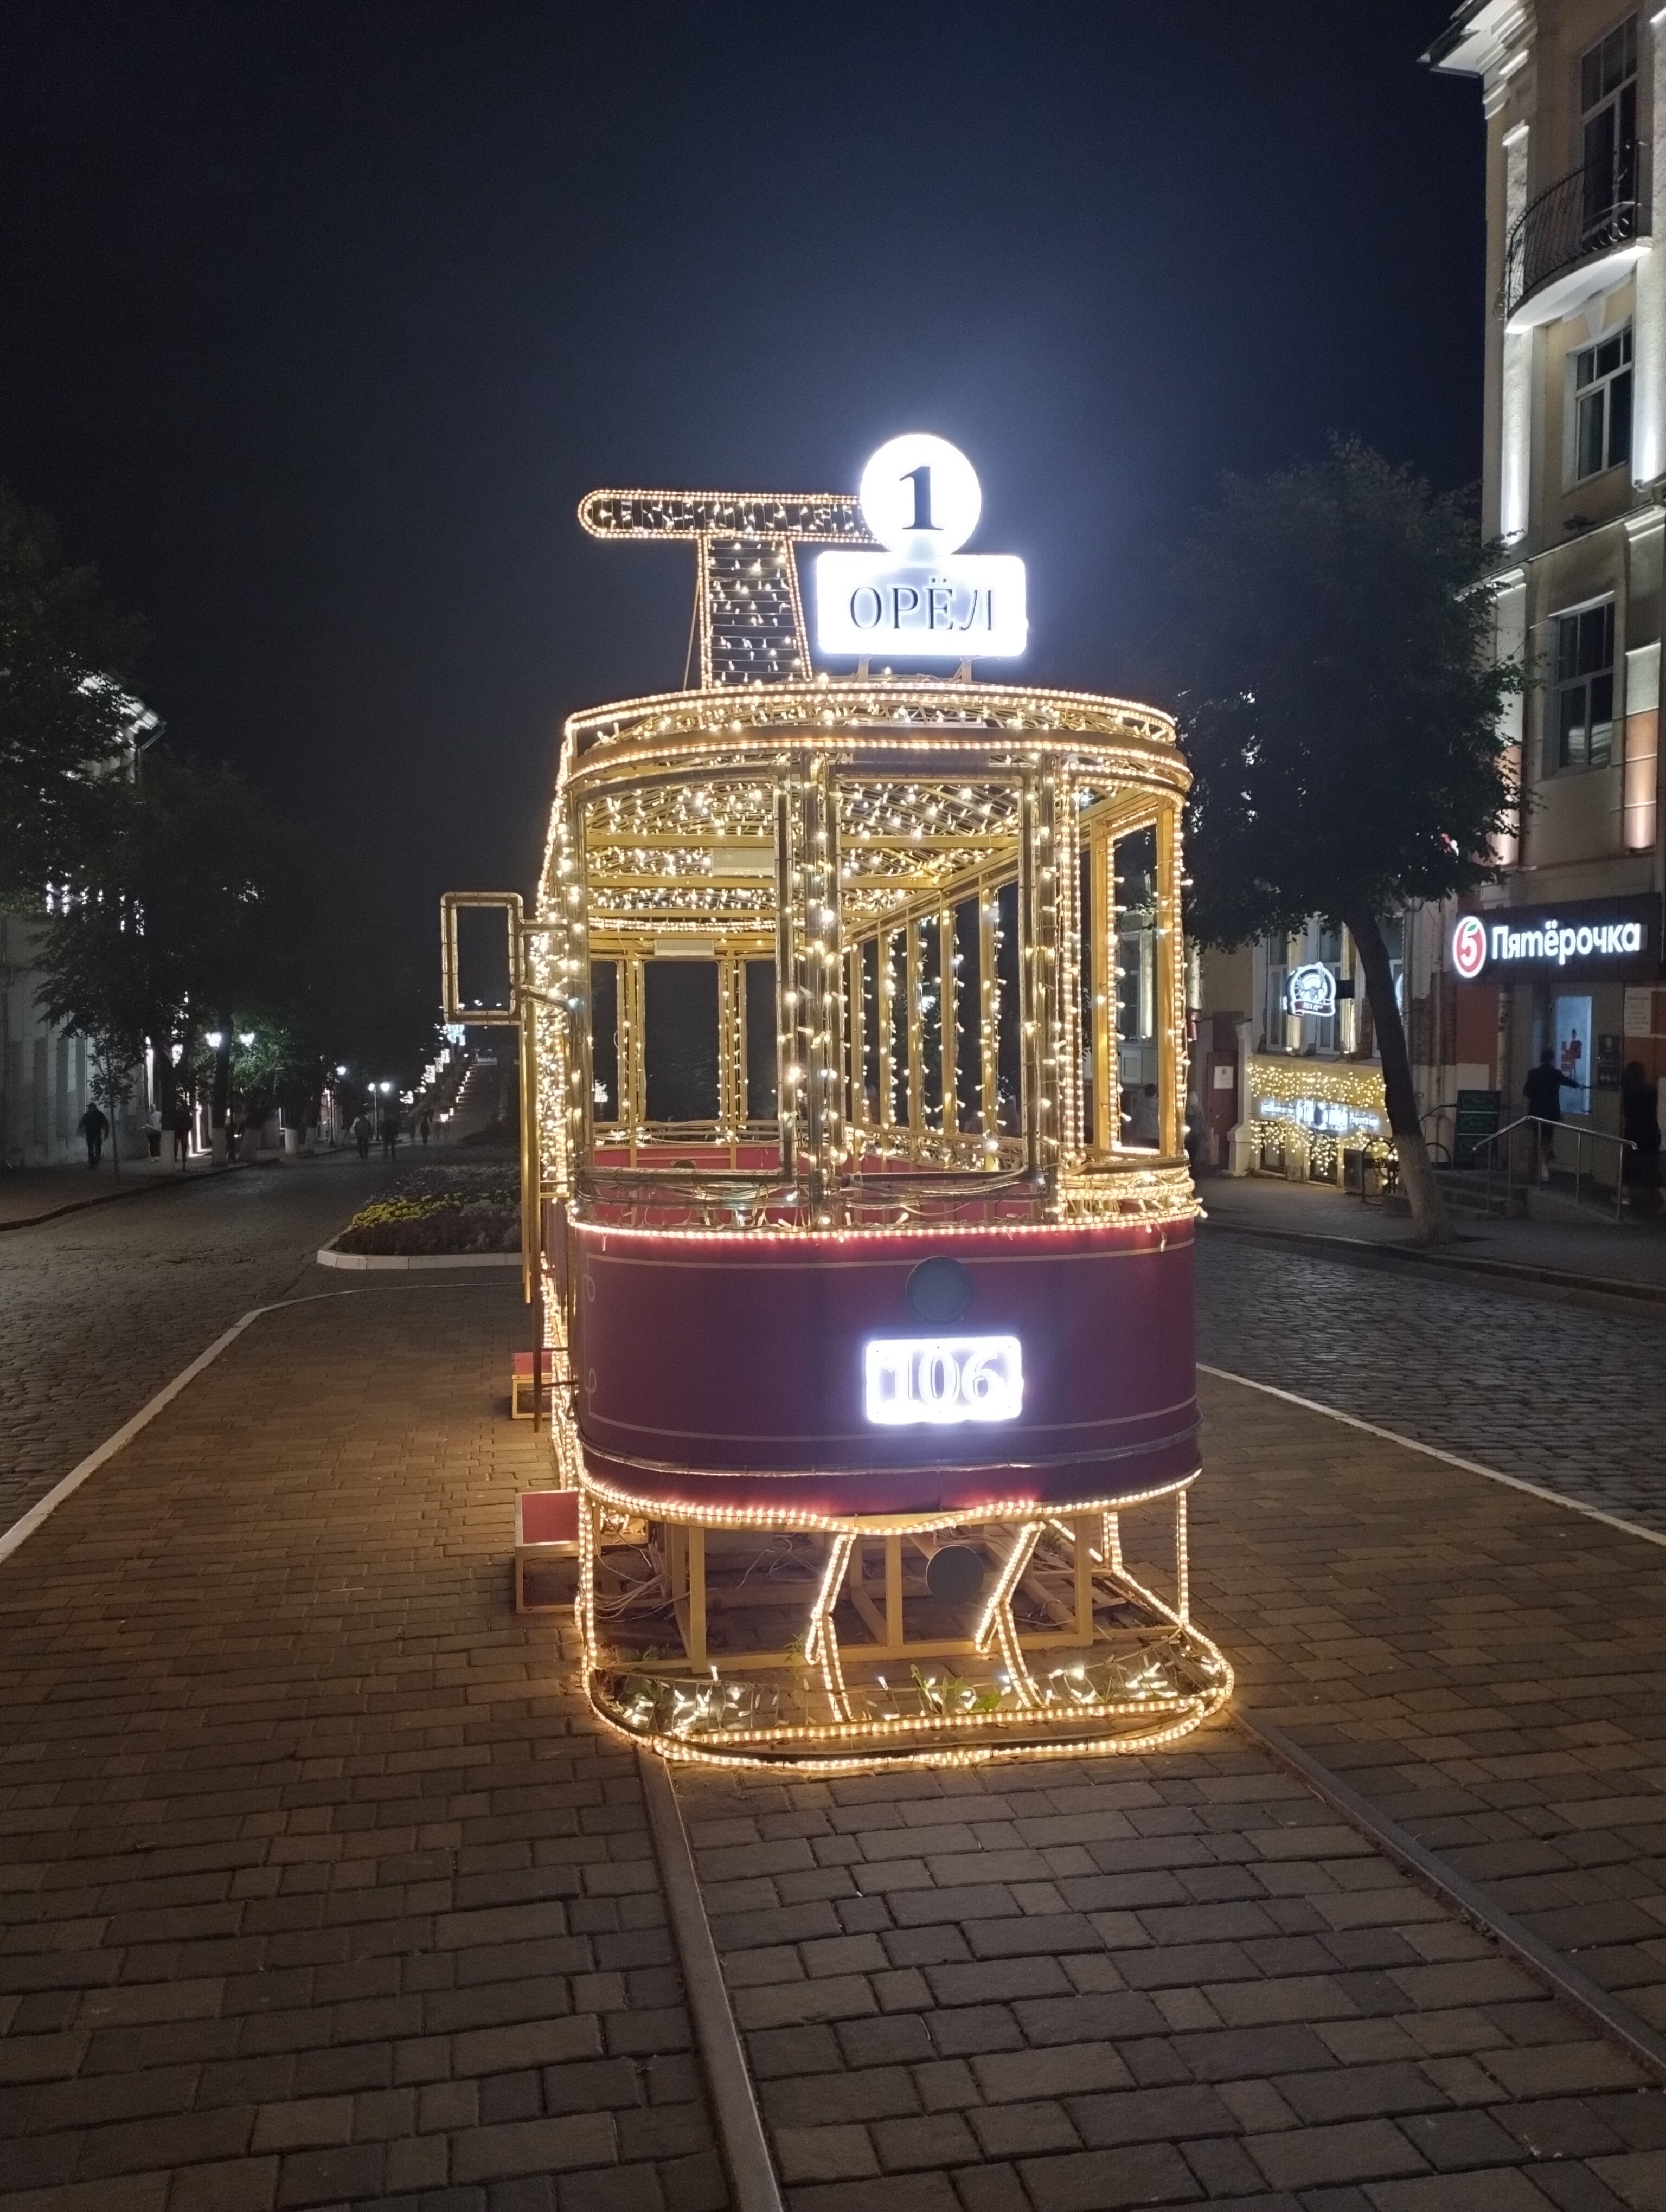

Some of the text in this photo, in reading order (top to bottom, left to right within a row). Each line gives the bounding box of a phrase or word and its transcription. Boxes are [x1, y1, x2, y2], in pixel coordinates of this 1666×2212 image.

[899, 466, 944, 530] 1
[850, 578, 992, 631] ОРЁЛ
[1491, 920, 1641, 965] Пятёрочка
[880, 1350, 1007, 1408] 106
